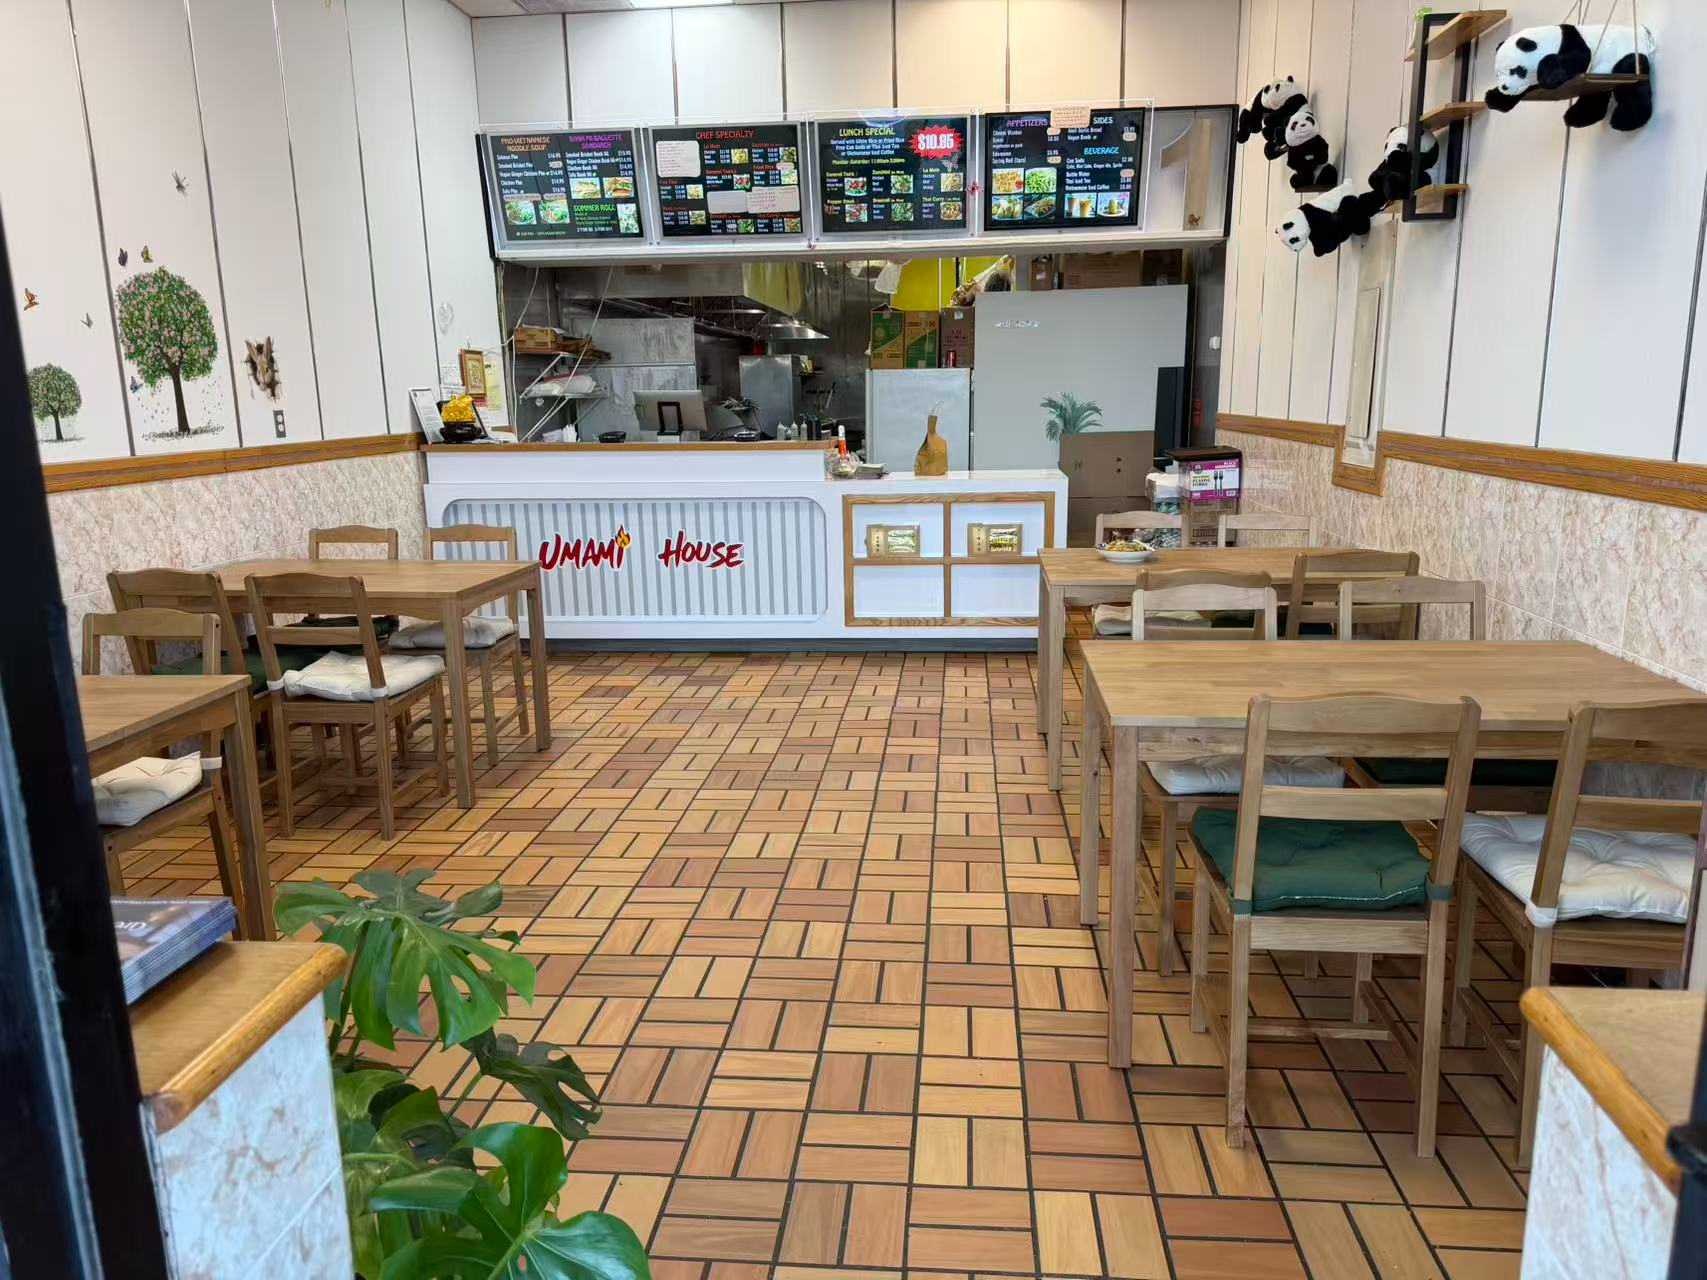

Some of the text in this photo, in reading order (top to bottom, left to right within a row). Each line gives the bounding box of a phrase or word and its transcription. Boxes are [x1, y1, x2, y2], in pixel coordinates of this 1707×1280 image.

[1007, 118, 1048, 127] APPETIZERS
[716, 130, 755, 139] SPECIALTY
[839, 127, 896, 137] LUNCH SPECIAL
[1084, 146, 1119, 155] BEVERAGE
